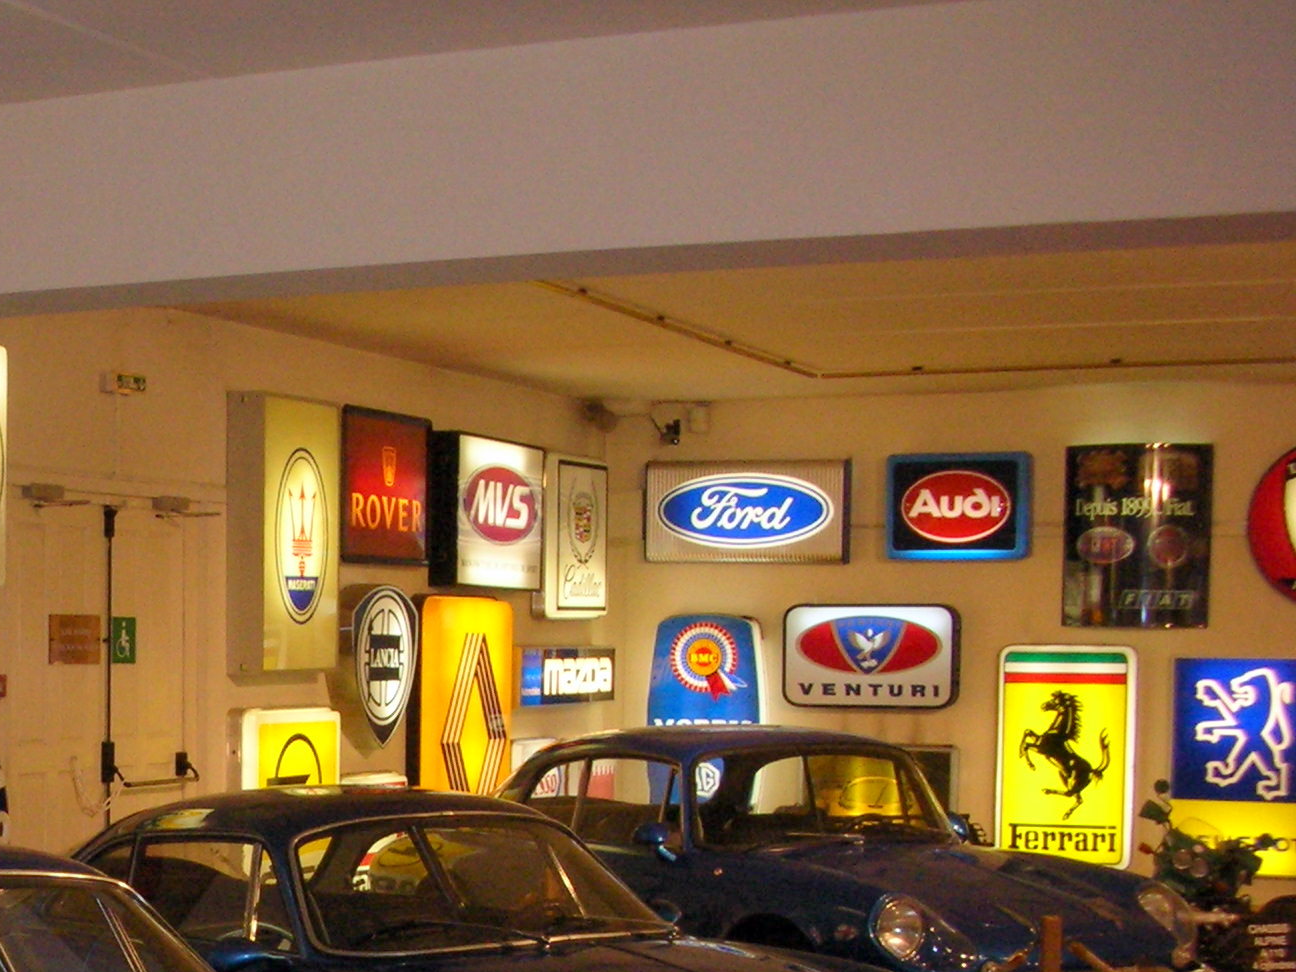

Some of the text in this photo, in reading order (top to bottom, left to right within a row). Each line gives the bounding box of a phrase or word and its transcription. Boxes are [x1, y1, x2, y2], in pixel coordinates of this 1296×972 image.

[352, 493, 422, 532] ROVER
[470, 479, 531, 530] MVS
[690, 485, 794, 531] Ford
[907, 487, 1004, 519] Audi
[370, 648, 400, 667] LANCIA
[690, 650, 718, 664] BMC
[799, 682, 940, 698] VENTURI
[1008, 823, 1117, 853] Ferrari
